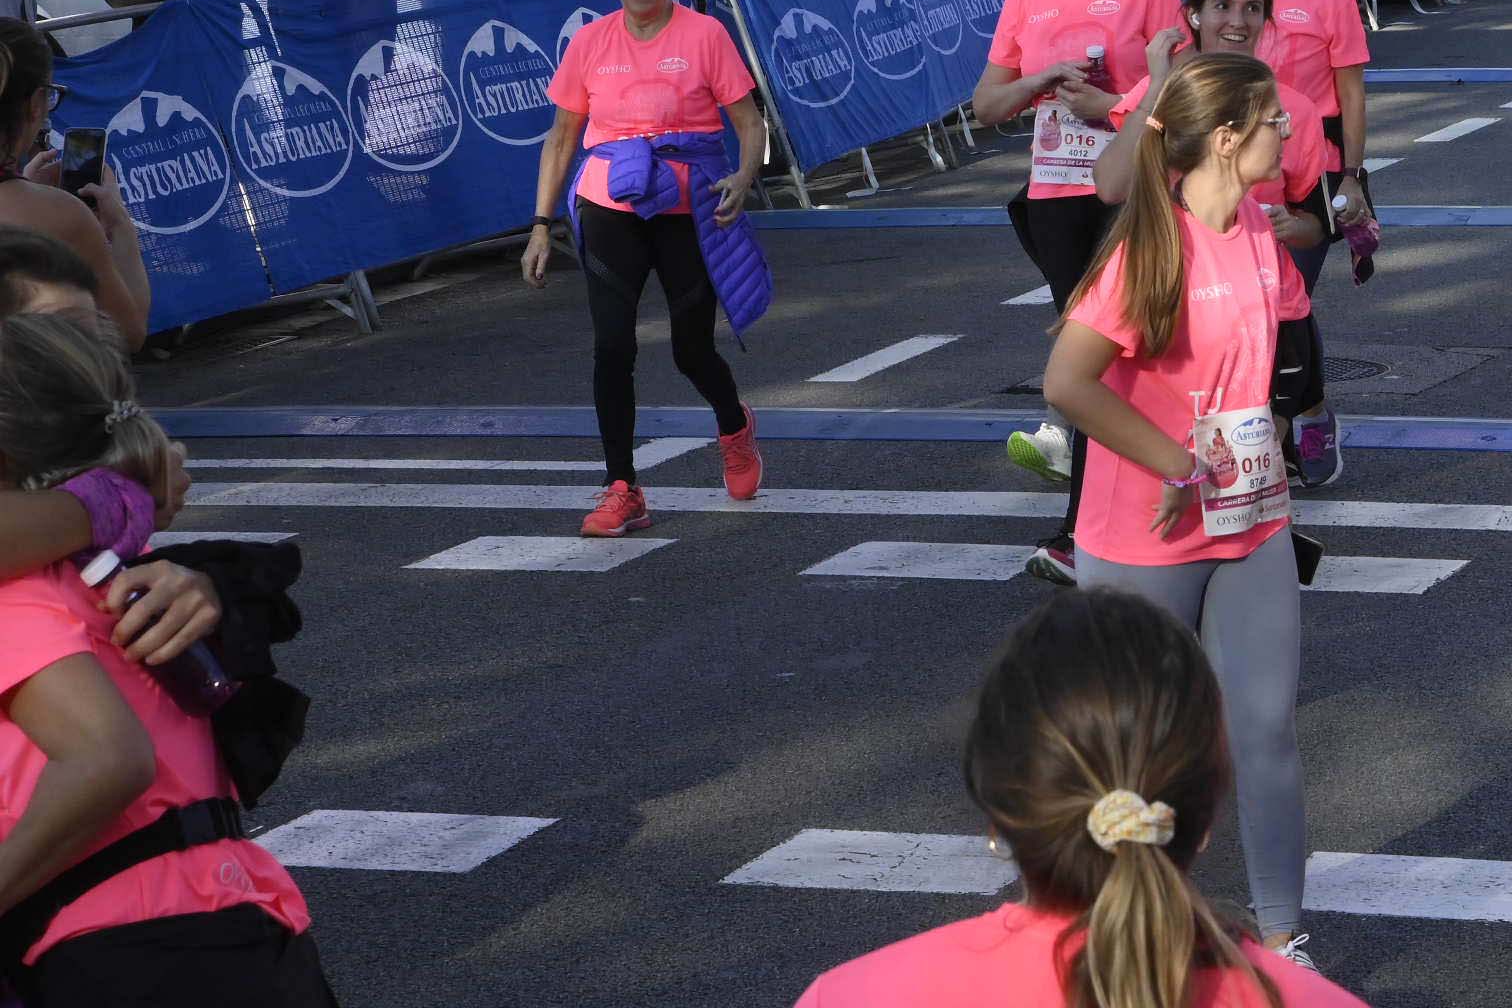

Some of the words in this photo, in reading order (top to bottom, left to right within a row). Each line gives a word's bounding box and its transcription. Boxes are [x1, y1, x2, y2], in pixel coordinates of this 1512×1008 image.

[470, 72, 553, 120] ASTURIAN
[245, 117, 348, 171] ASTURIANA
[1064, 133, 1096, 147] 016
[1190, 281, 1234, 303] OYSHO
[1241, 452, 1271, 474] 016
